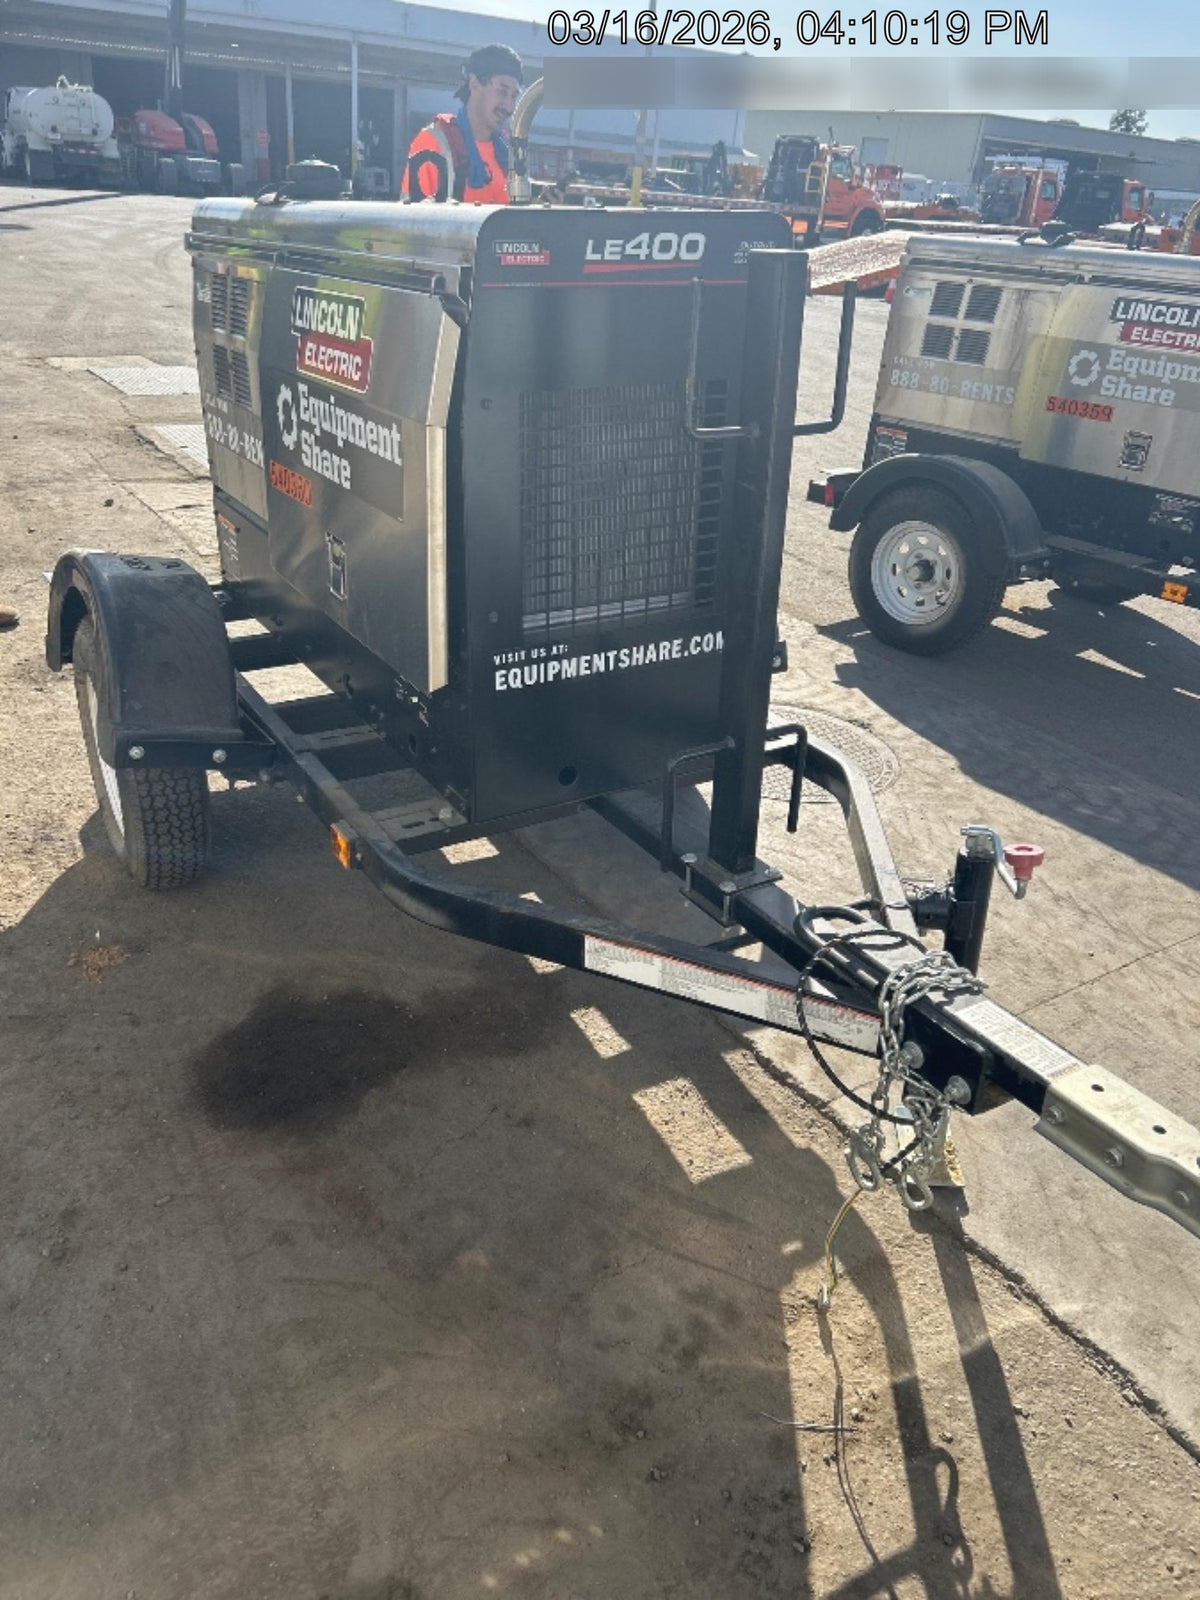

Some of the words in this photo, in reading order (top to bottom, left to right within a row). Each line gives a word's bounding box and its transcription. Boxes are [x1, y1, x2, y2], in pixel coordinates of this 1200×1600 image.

[495, 243, 540, 254] LINCOLN
[585, 232, 707, 261] LE400
[295, 295, 360, 342] LINCOLN
[305, 341, 362, 382] ELECTRIC
[1101, 374, 1177, 406] Share
[297, 382, 403, 466] Equipment
[300, 429, 352, 490] Share
[493, 649, 526, 666] VISIT
[530, 647, 548, 659] US
[551, 643, 569, 655] AT:
